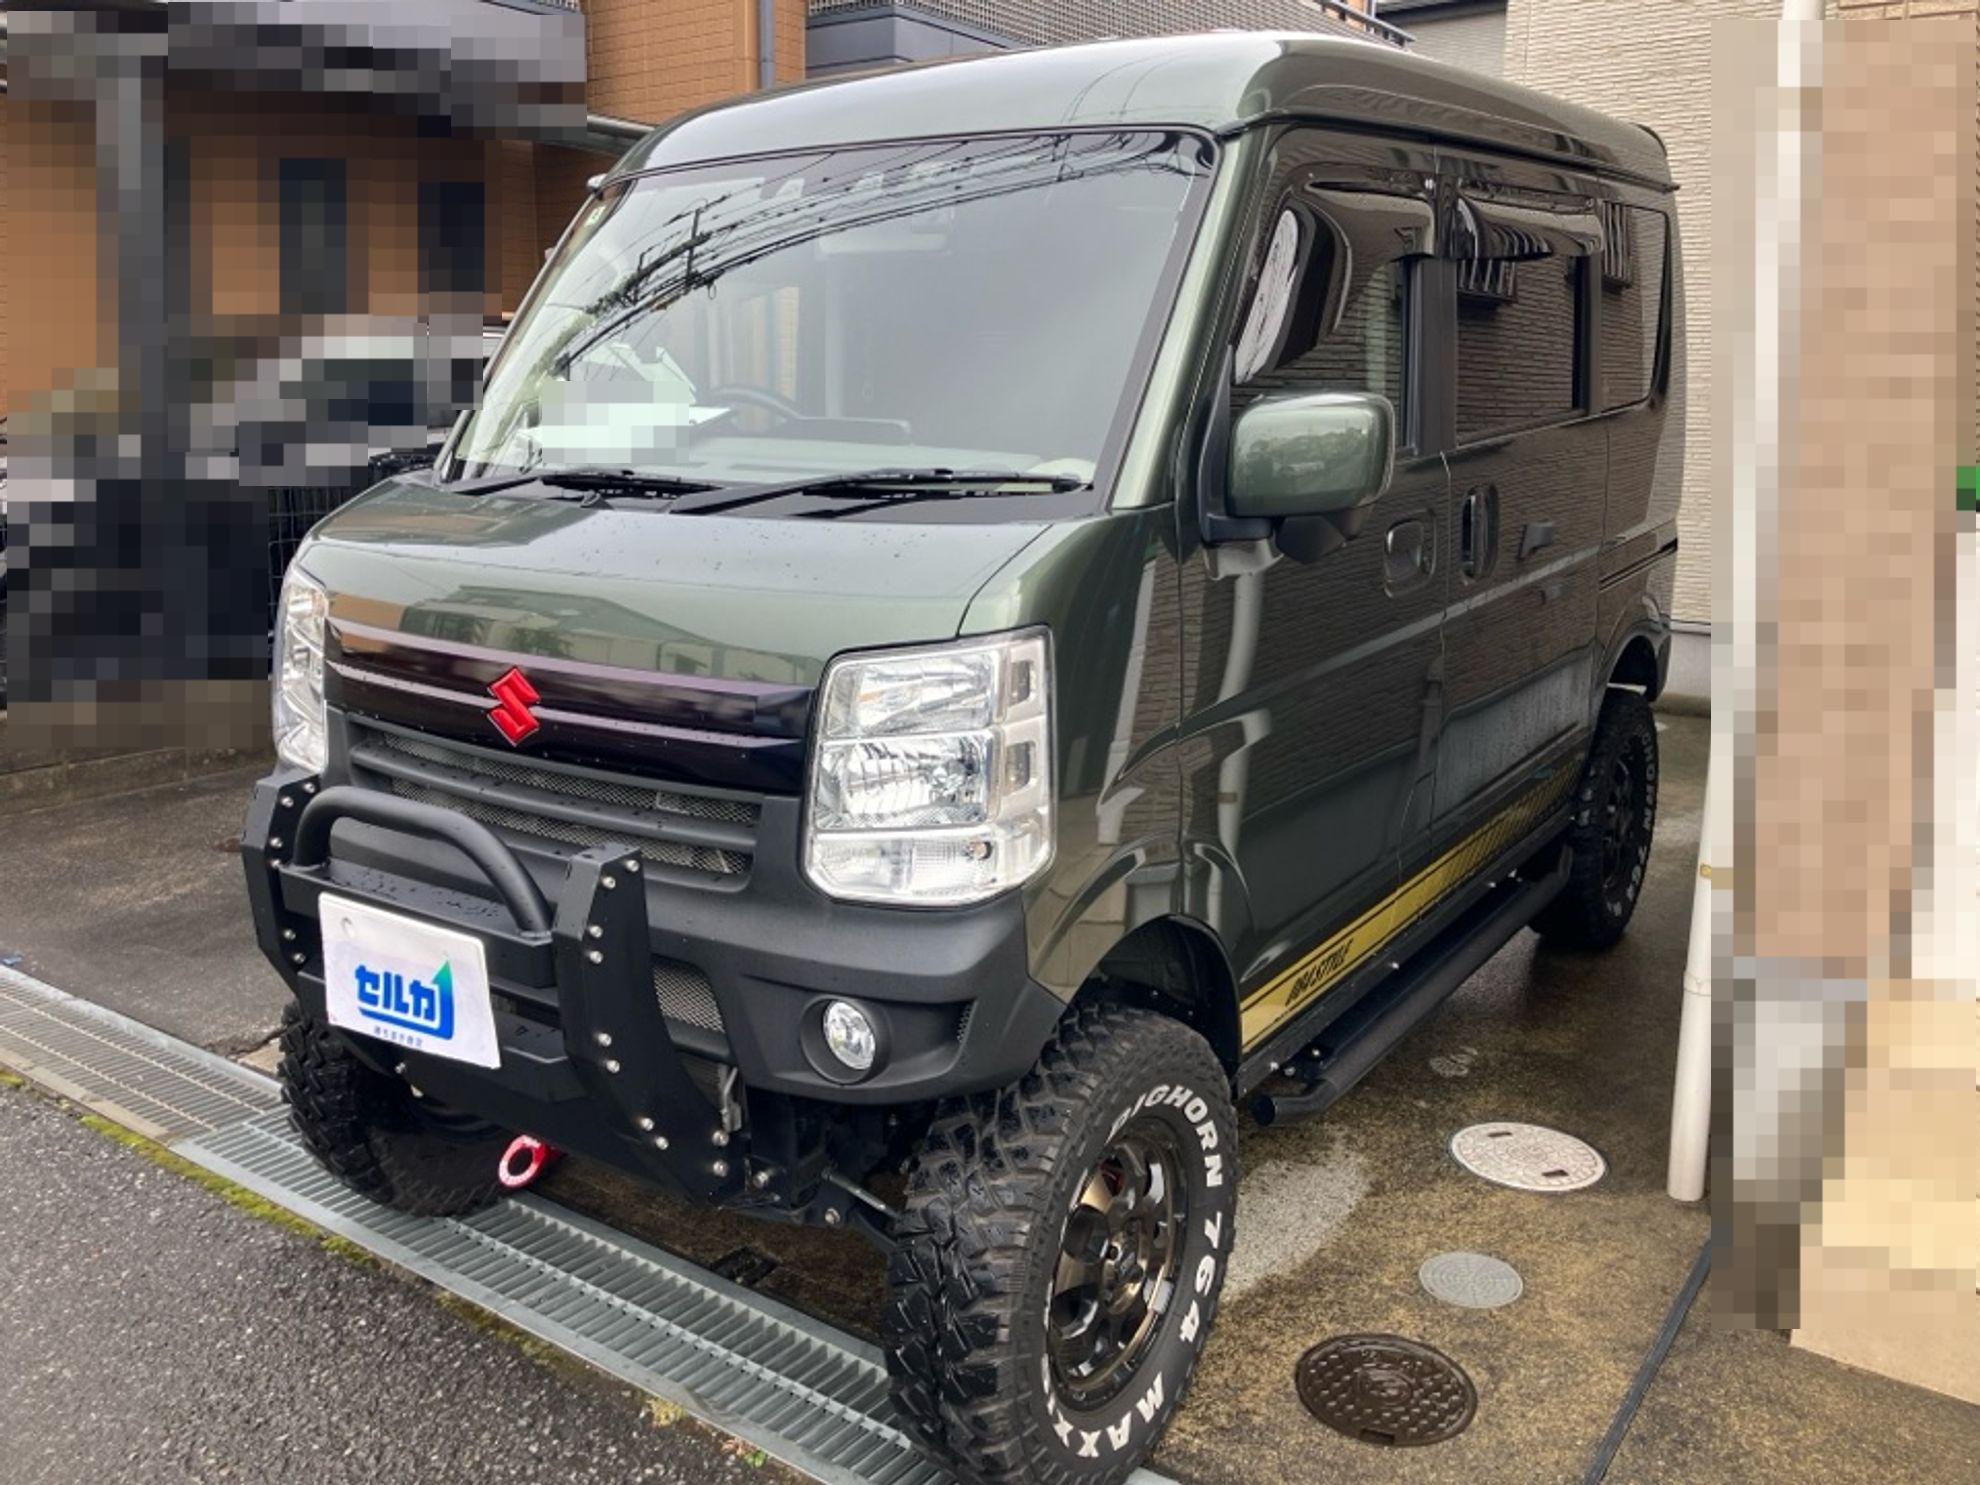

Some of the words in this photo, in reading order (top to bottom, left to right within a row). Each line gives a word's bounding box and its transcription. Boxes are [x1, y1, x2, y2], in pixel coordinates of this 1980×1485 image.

[355, 964, 436, 1022] セルカ
[1104, 1085, 1222, 1187] BIGHORN
[1180, 1211, 1222, 1342] 764
